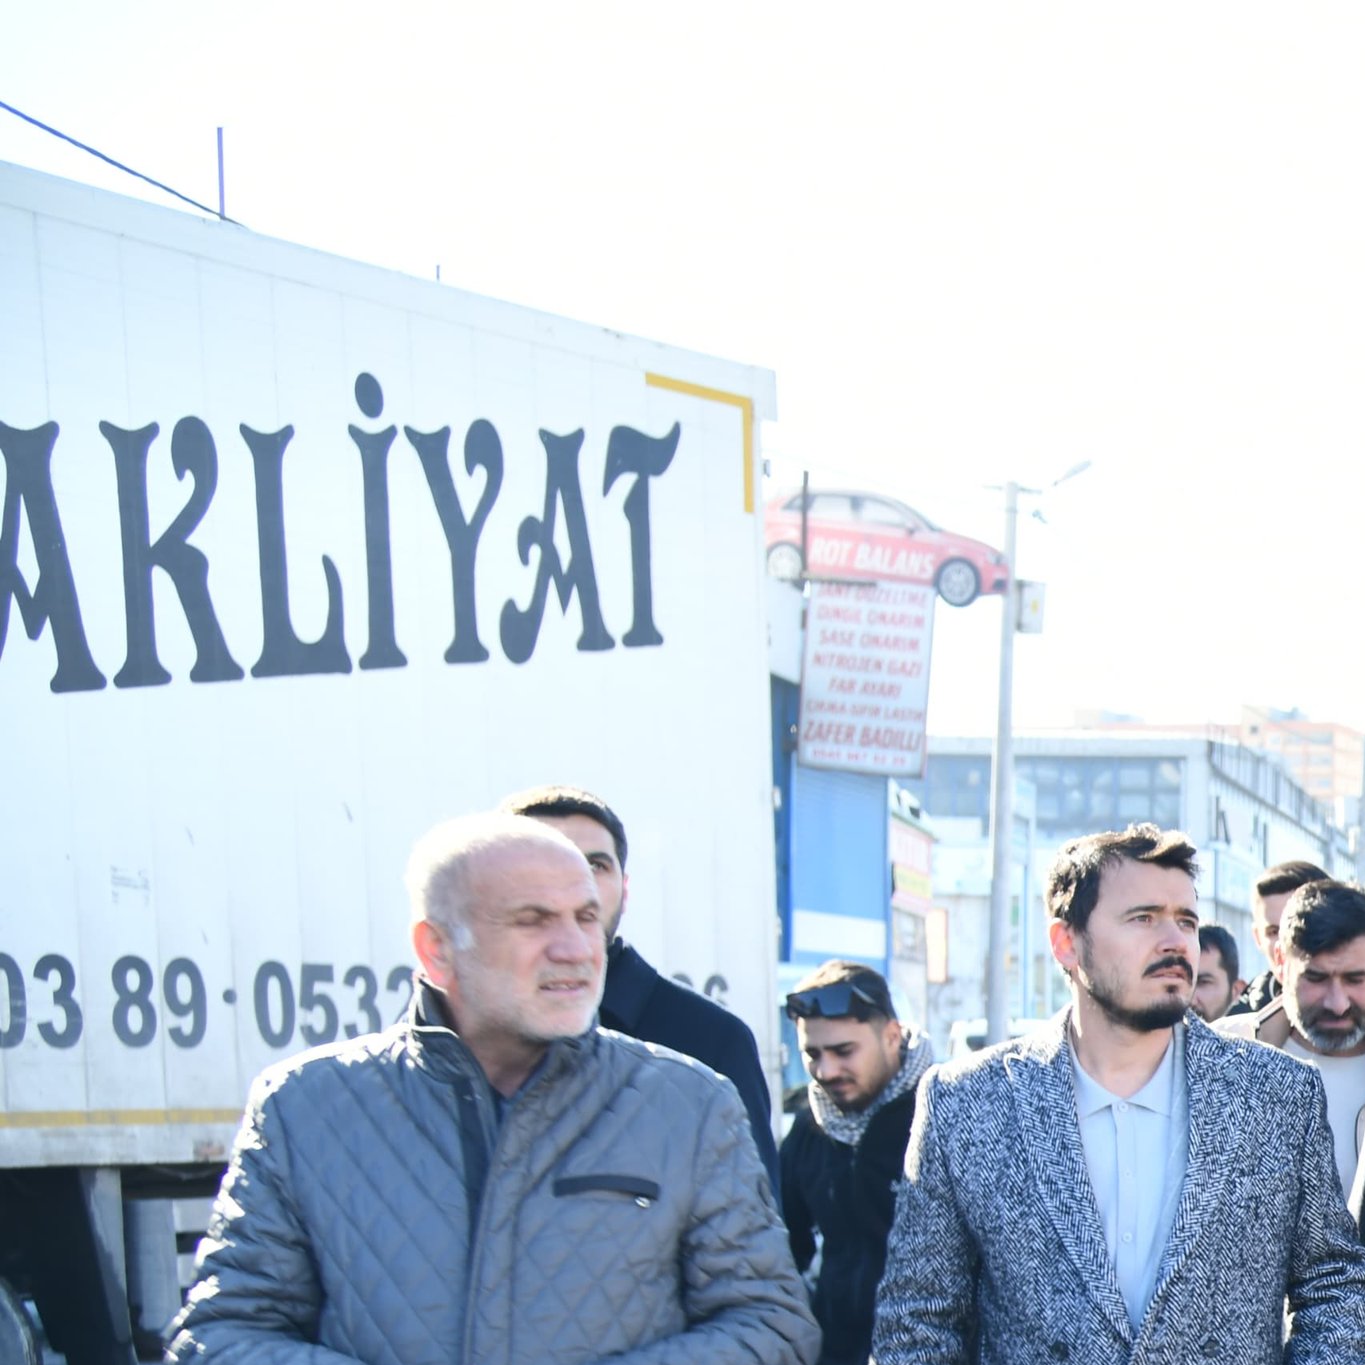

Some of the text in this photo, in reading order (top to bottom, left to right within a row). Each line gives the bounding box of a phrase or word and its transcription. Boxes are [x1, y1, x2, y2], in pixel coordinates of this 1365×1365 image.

[811, 538, 934, 578] ROT BALANS
[827, 676, 857, 694] FAR
[803, 719, 857, 744] ZAFER
[111, 955, 207, 1048] 89
